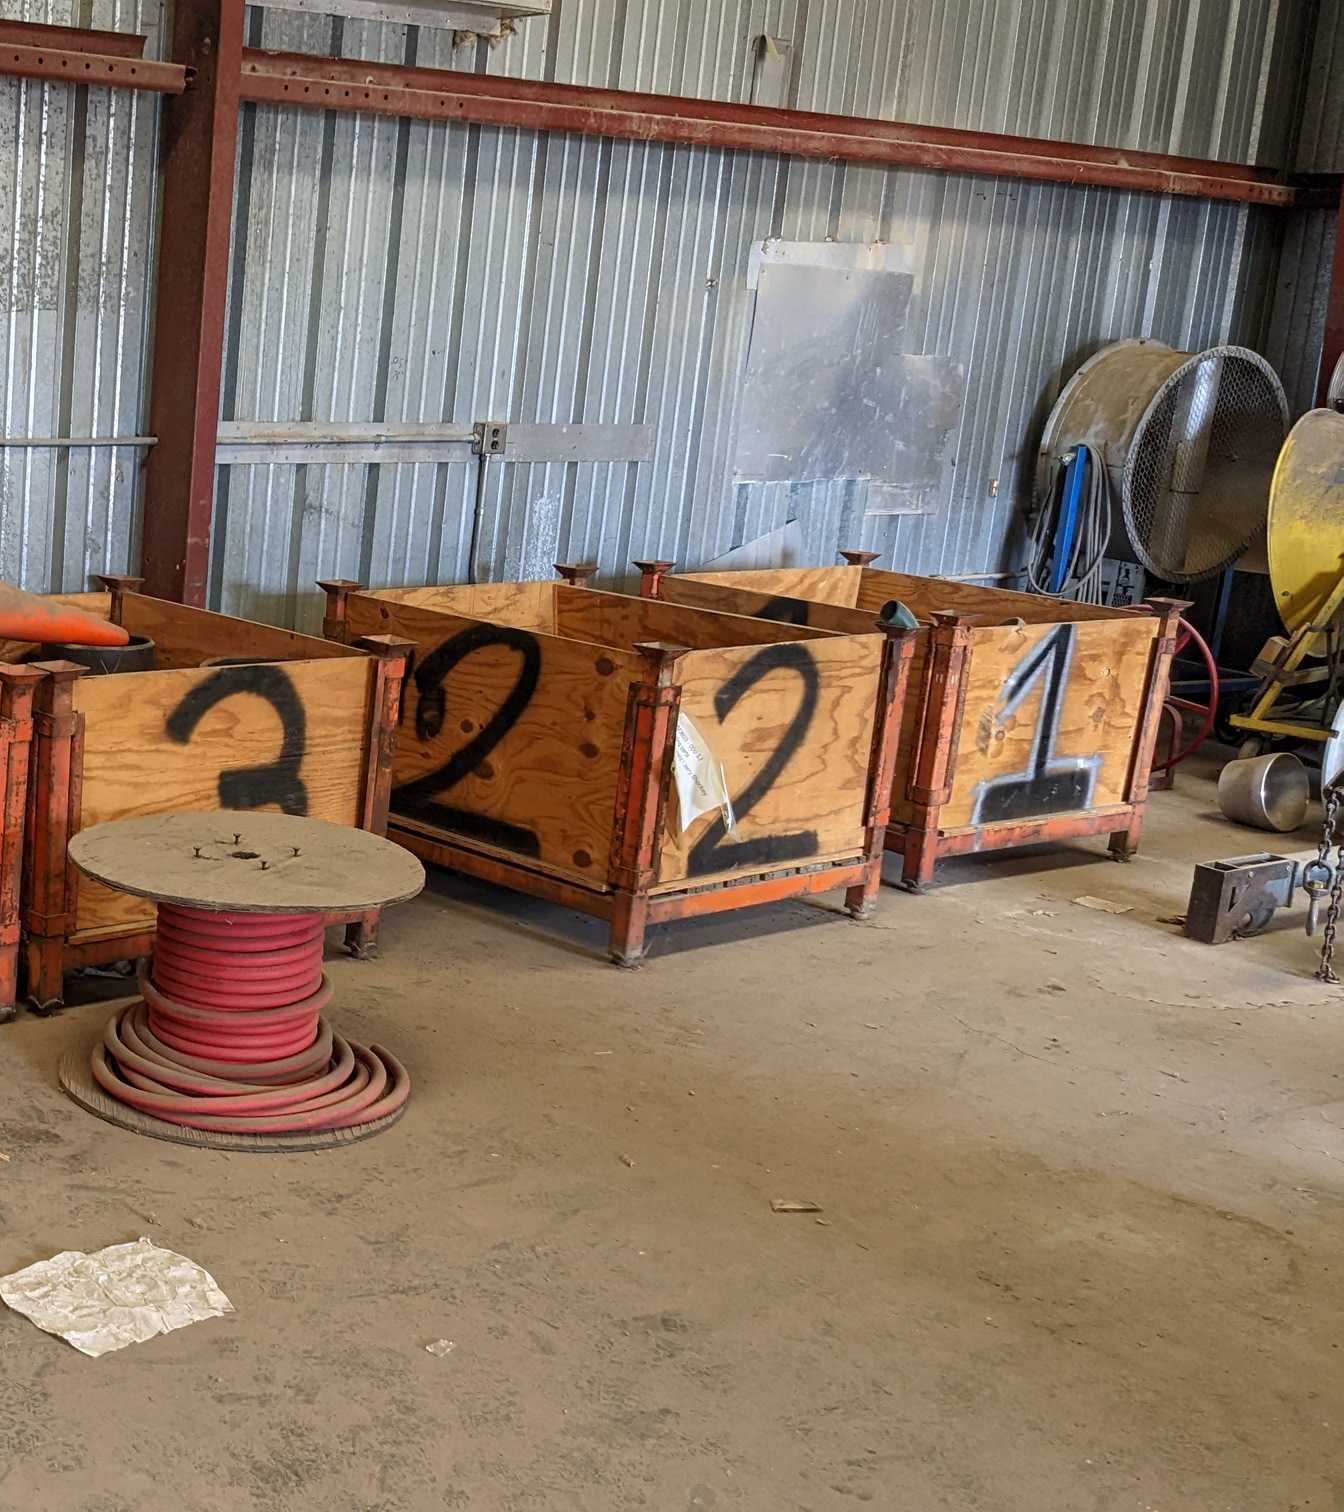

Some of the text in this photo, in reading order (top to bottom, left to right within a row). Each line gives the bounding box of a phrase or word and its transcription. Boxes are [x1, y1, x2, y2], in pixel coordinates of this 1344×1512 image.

[165, 663, 309, 816] 3
[390, 624, 541, 861] 2
[686, 641, 820, 878] 2
[972, 624, 1101, 827] 1
